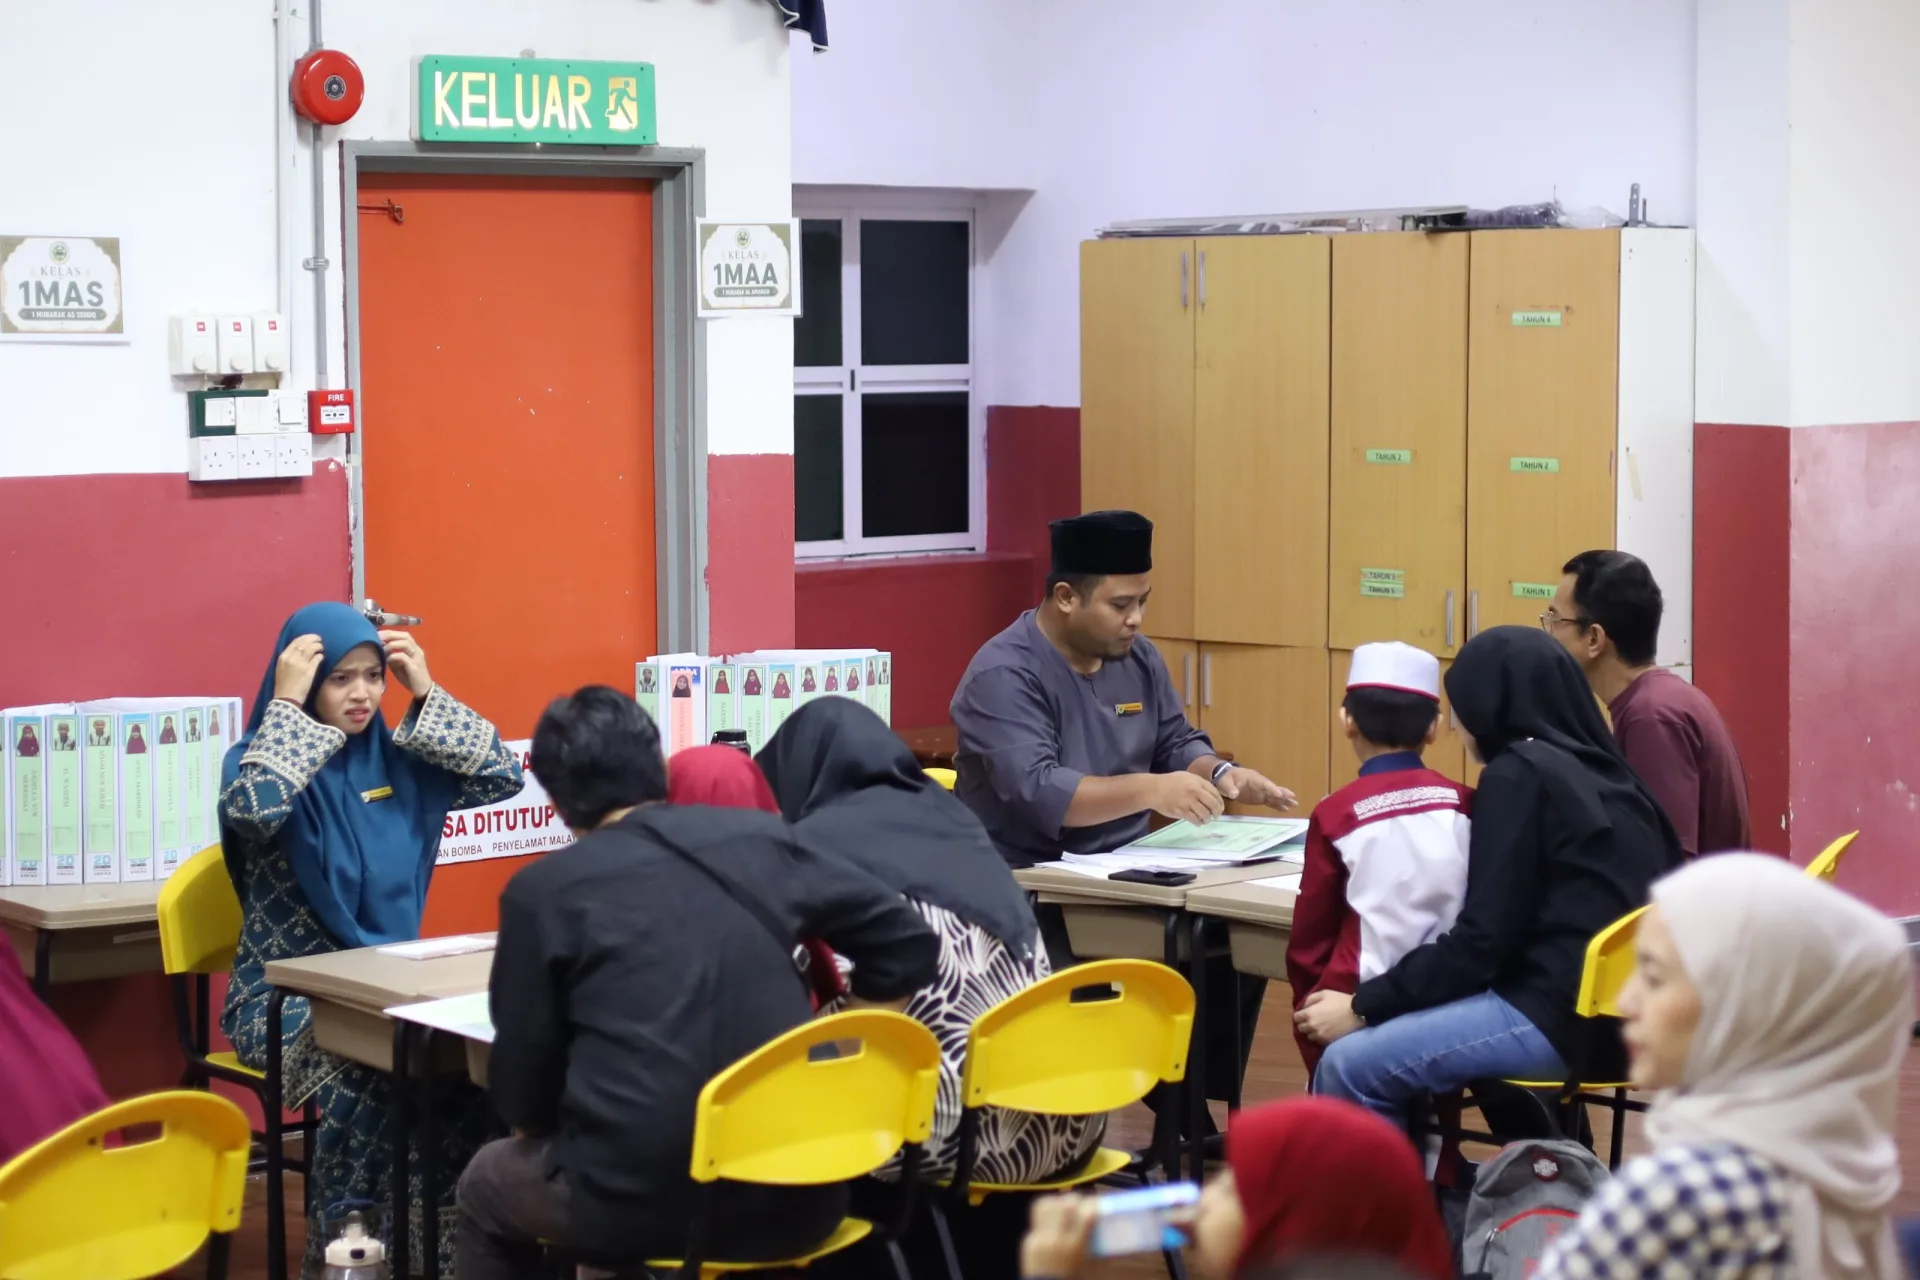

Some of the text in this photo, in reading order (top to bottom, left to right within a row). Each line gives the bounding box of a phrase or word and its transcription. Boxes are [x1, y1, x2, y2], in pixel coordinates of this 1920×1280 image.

[434, 71, 593, 130] KELUAR
[728, 250, 760, 260] KELAS
[40, 266, 82, 277] KELAS
[713, 263, 778, 285] 1MAA
[18, 280, 104, 308] 1MAS
[1522, 315, 1545, 324] TAHUN
[327, 394, 345, 402] FIRE
[1375, 453, 1397, 461] TAHUN
[1520, 461, 1544, 470] TAHUN
[1368, 586, 1391, 595] TAHUN
[1522, 587, 1545, 596] TAHUN
[474, 805, 555, 835] DITUTUP
[451, 844, 482, 857] BOMBA
[492, 837, 547, 853] PENYELAMAT
[549, 834, 577, 845] MALA
[56, 855, 75, 867] 2D
[94, 854, 112, 866] 2D
